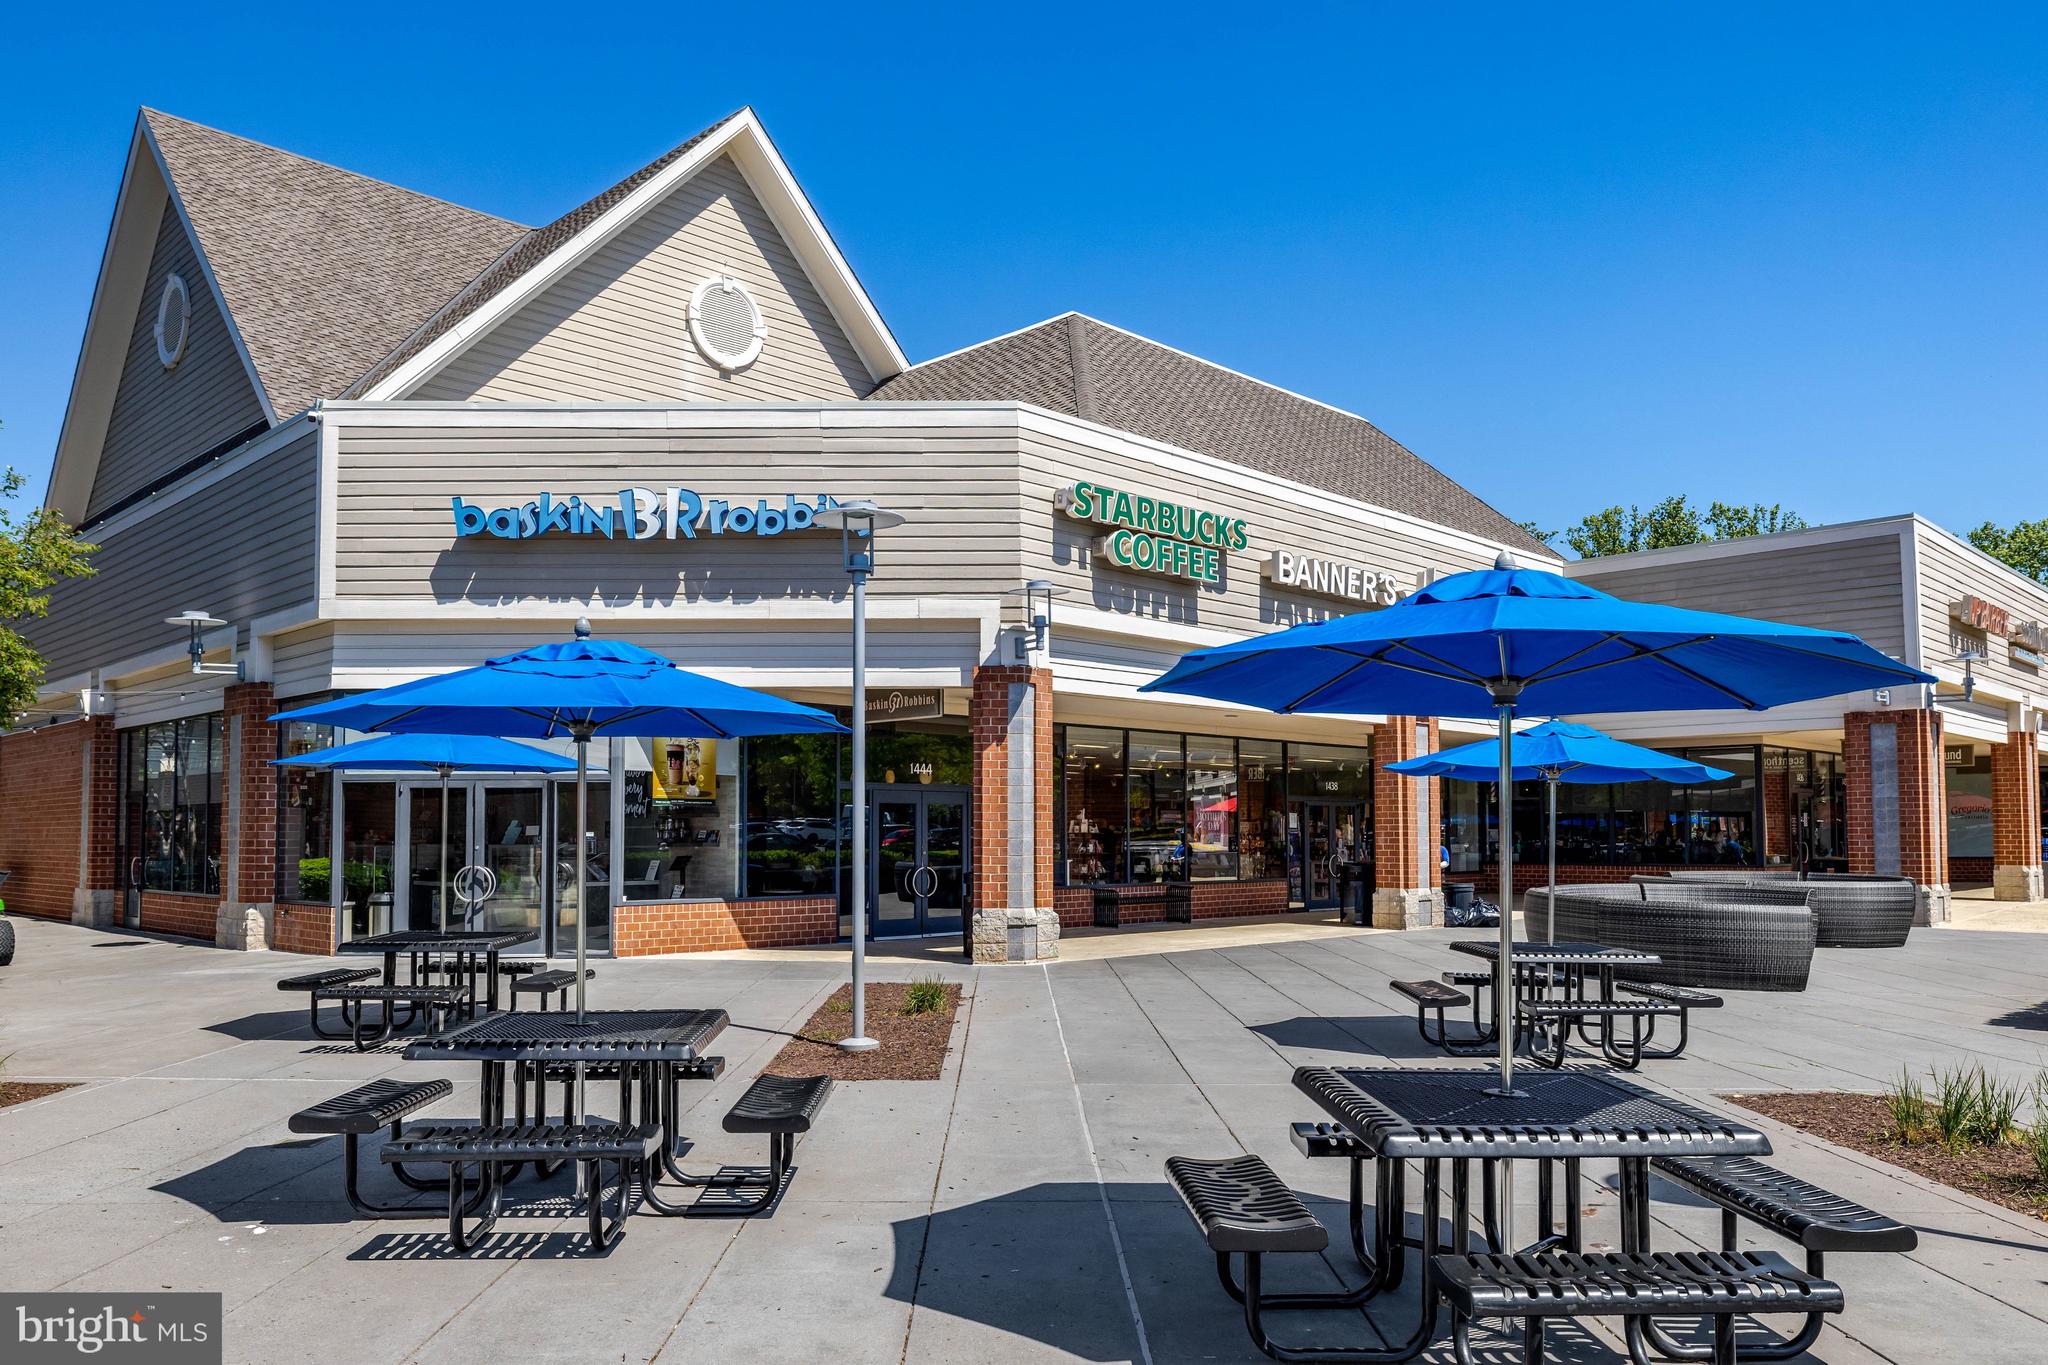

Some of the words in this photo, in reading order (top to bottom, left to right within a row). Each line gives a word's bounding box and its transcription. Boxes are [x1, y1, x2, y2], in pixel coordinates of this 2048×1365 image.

[452, 492, 613, 540] baskin
[708, 493, 871, 538] robbi
[1073, 481, 1249, 552] STARBUCKS
[1111, 530, 1220, 583] COFFEE
[1278, 550, 1398, 606] BANNER'S
[904, 694, 935, 707] Robbins
[910, 762, 933, 775] 1444
[1325, 781, 1339, 791] 1438
